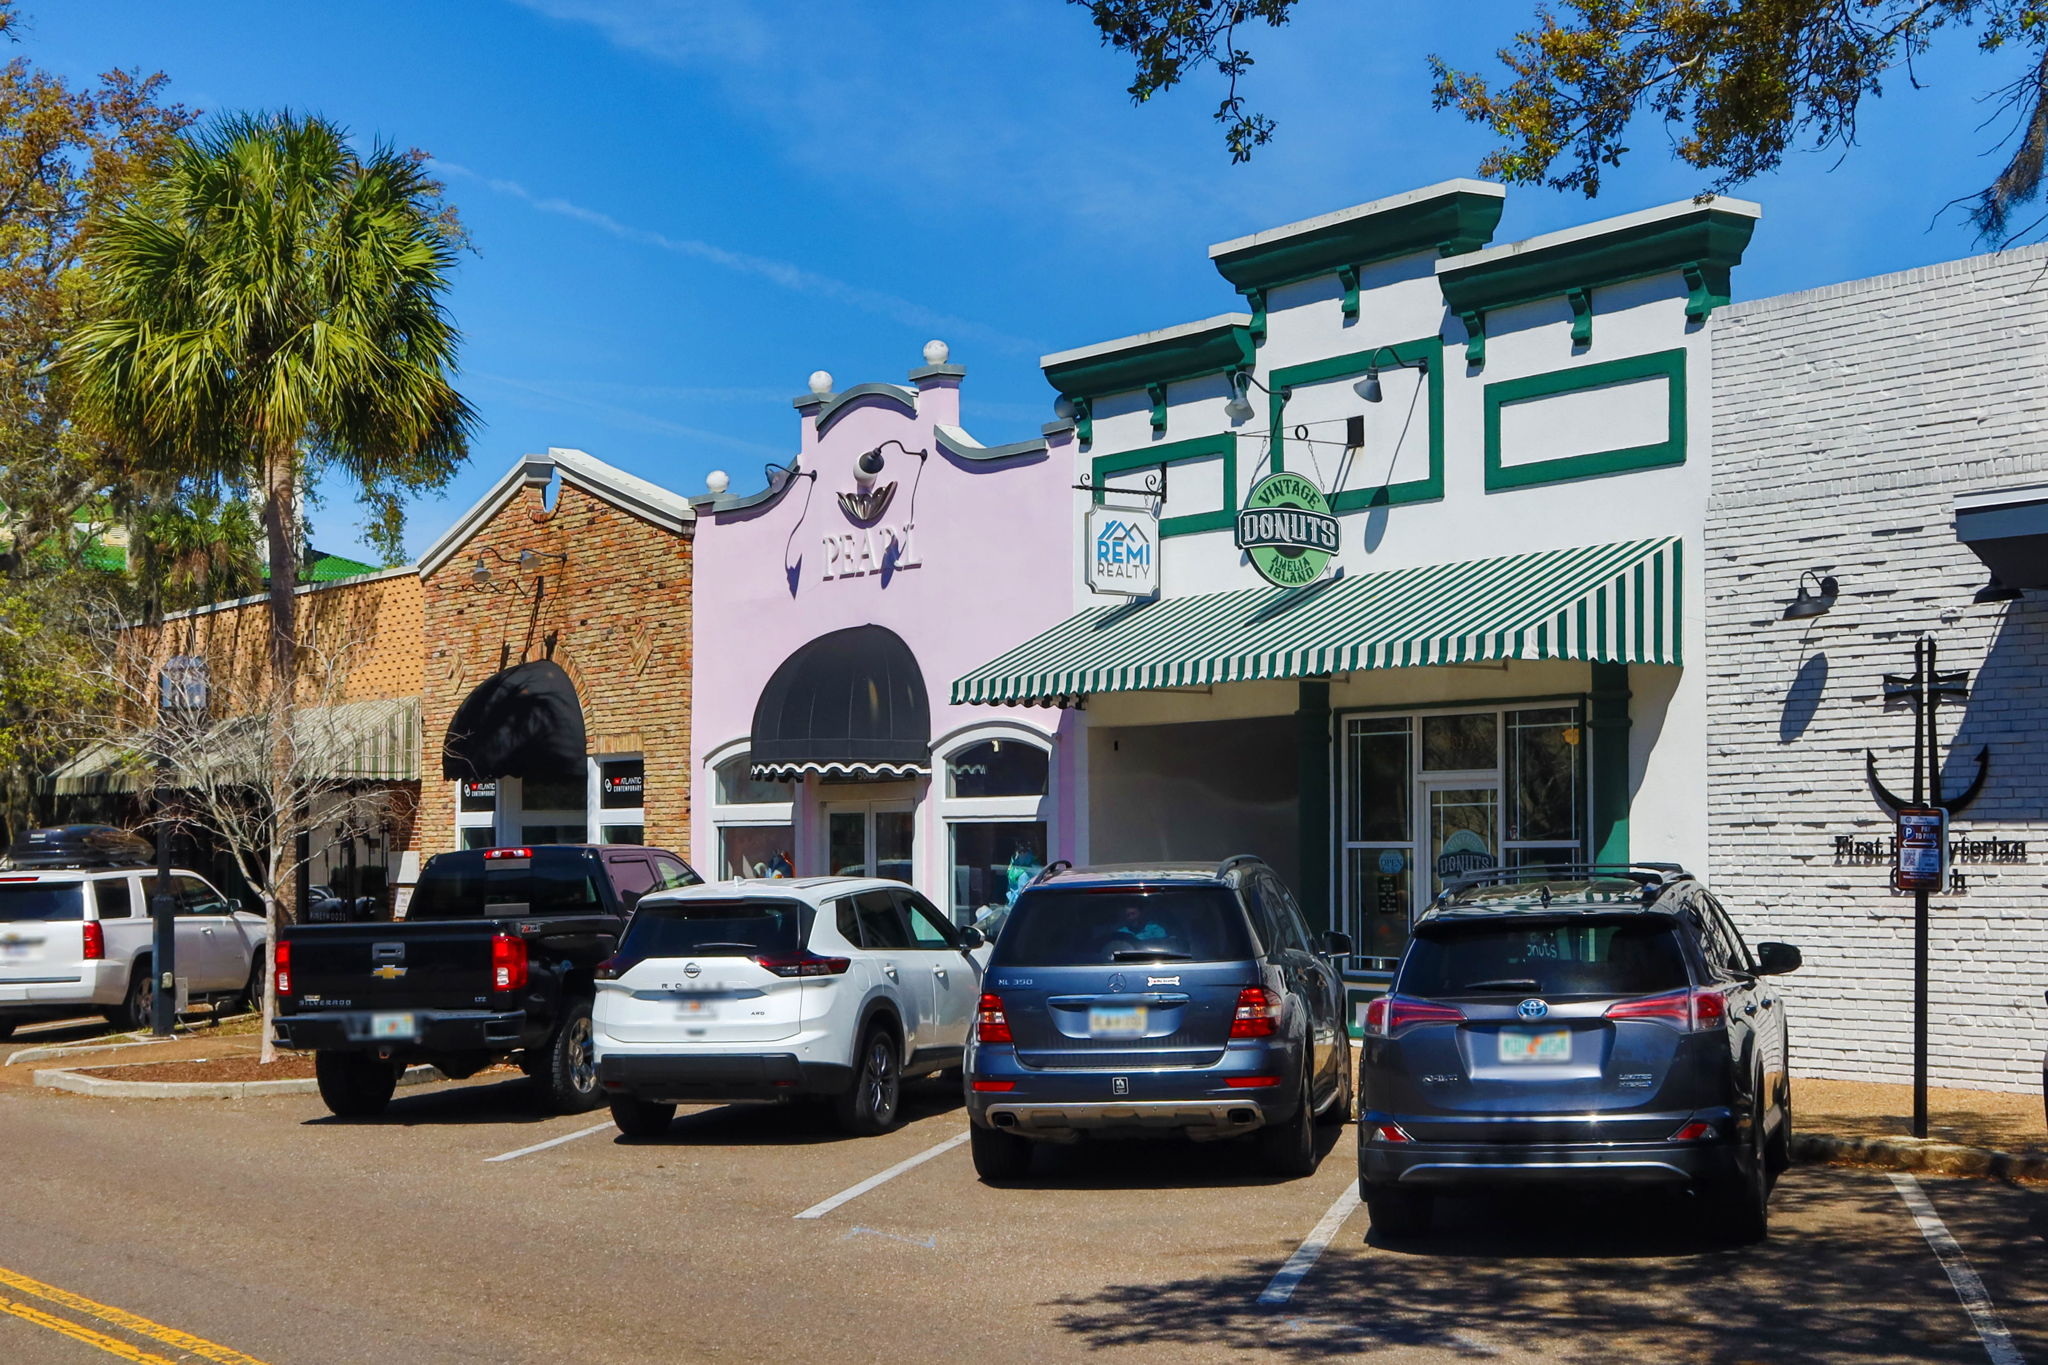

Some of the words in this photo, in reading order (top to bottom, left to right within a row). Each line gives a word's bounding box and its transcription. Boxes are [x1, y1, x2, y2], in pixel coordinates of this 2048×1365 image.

[1258, 479, 1320, 509] VINTAGE
[1243, 513, 1336, 548] DONUTS
[823, 524, 923, 578] PEARL
[1097, 540, 1150, 565] REMI
[1097, 562, 1150, 579] REALTY
[1271, 554, 1311, 572] AMELIA
[1268, 564, 1315, 584] ISLAND
[476, 782, 496, 790] ATLANTIC
[620, 776, 642, 785] ATLANTIC
[1905, 827, 1913, 838] P
[1834, 835, 1884, 857] First
[1440, 855, 1490, 874] DONUTS
